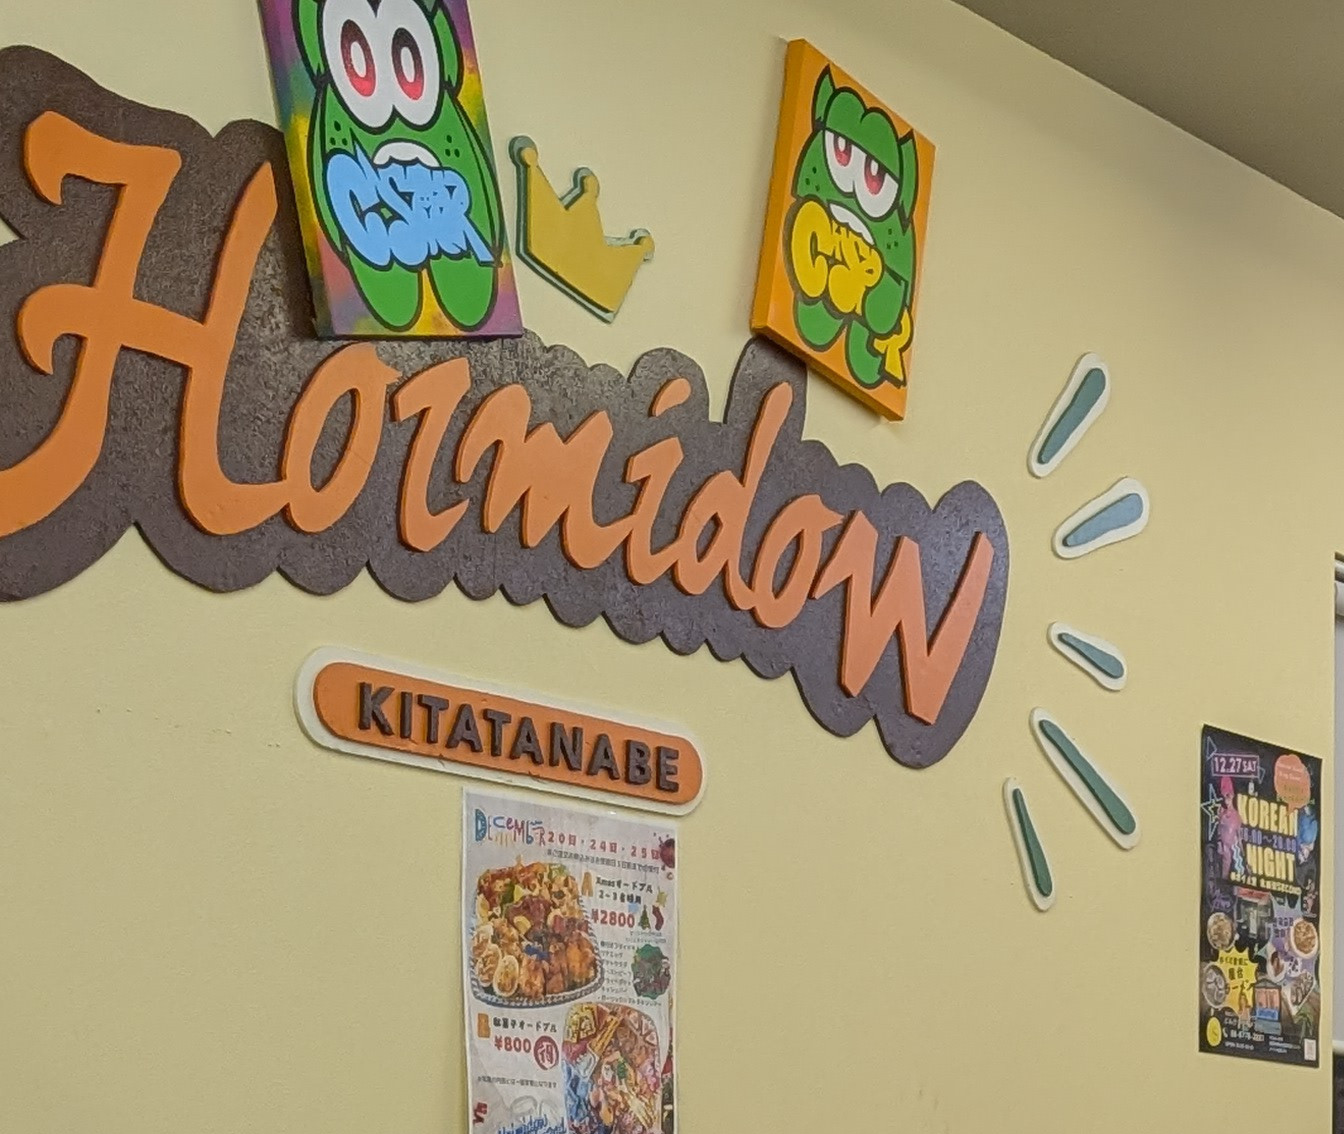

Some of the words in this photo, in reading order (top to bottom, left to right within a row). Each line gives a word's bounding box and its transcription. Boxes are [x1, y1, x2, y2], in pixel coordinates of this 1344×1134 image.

[0, 110, 994, 726] Hormidow
[358, 682, 680, 793] KITATANABE
[1214, 757, 1241, 773] 12.27
[1242, 760, 1257, 773] SAT
[1237, 793, 1299, 836] KOREAN
[1246, 843, 1296, 882] NIGHT
[591, 908, 635, 928] ¥2800
[494, 1036, 532, 1053] ¥800
